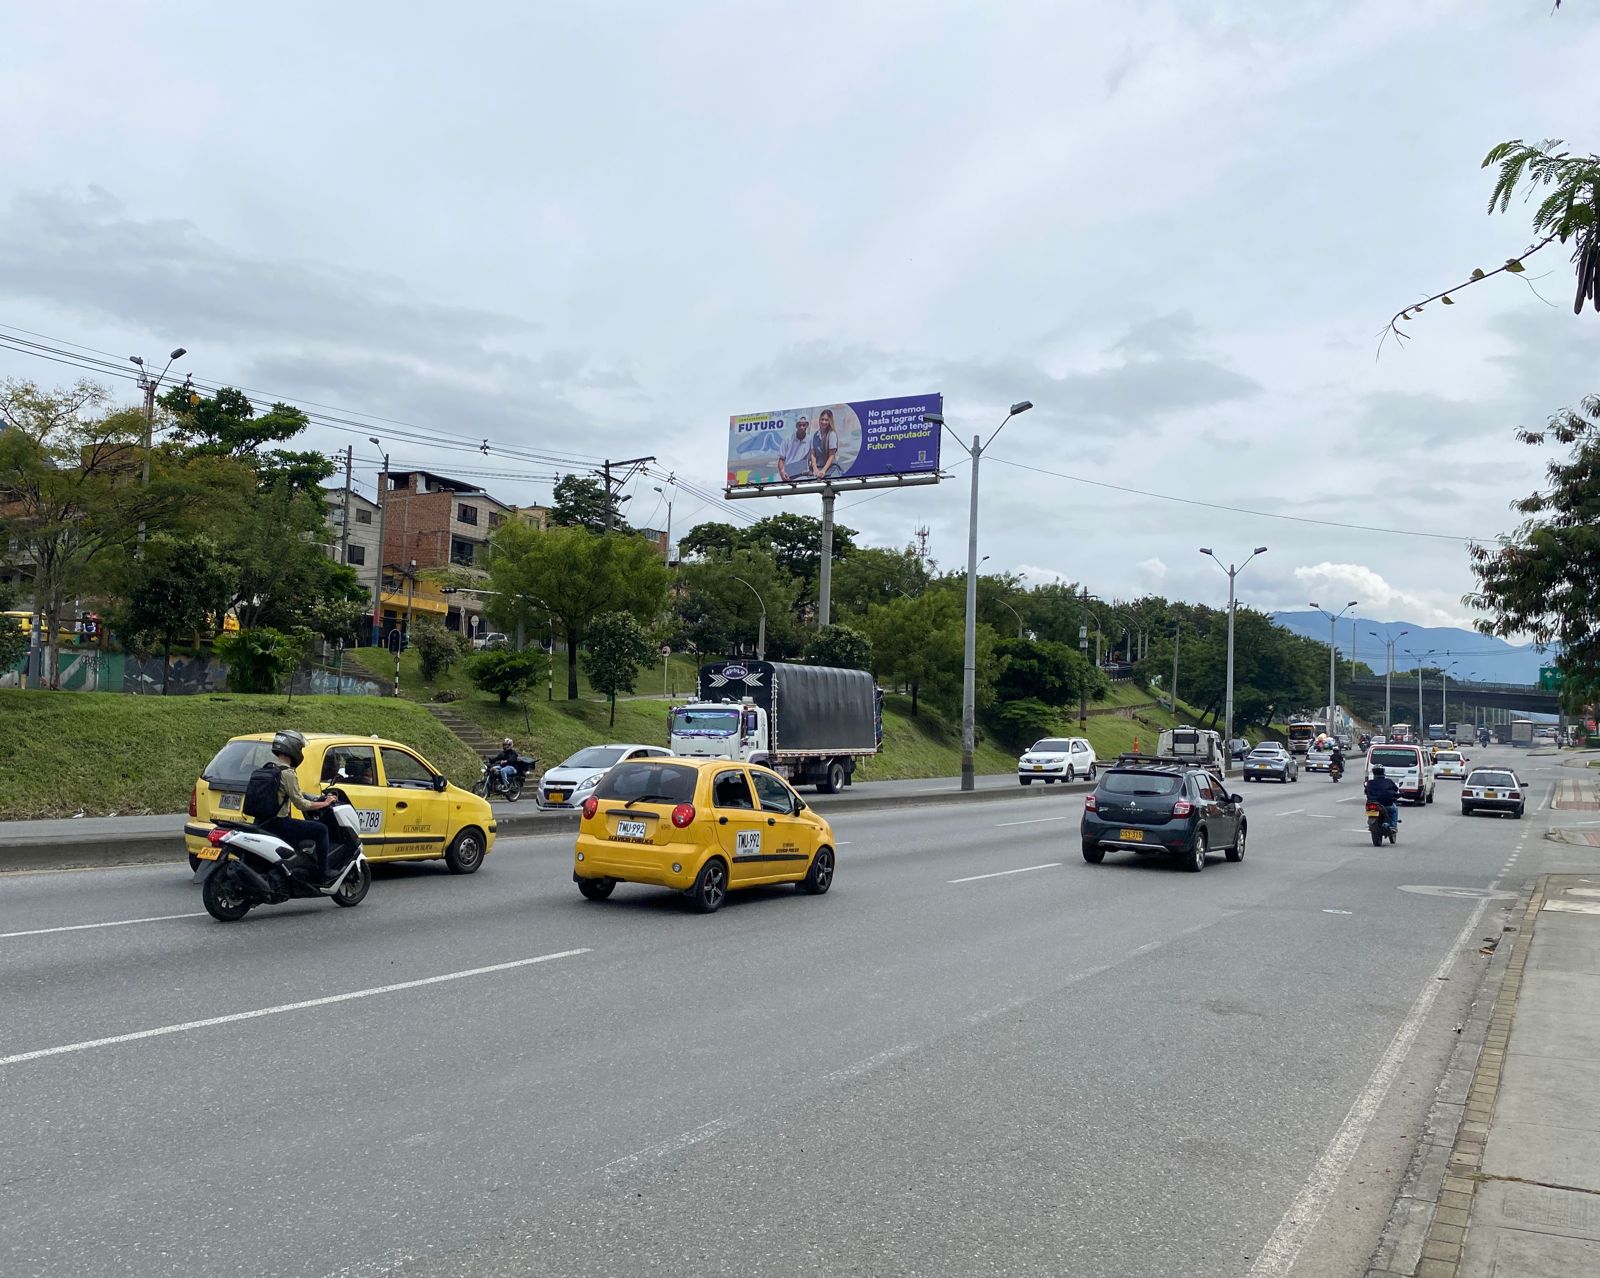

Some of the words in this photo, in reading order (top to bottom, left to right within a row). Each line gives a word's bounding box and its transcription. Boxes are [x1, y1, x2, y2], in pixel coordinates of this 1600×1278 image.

[881, 406, 926, 417] pararemos
[738, 419, 784, 432] FUTURO
[868, 417, 890, 426] hasta
[891, 415, 916, 424] lograr
[867, 425, 887, 433] cada
[889, 424, 908, 432] niño
[910, 422, 933, 430] tenga
[880, 430, 931, 441] Computador
[867, 443, 896, 451] Futuro.
